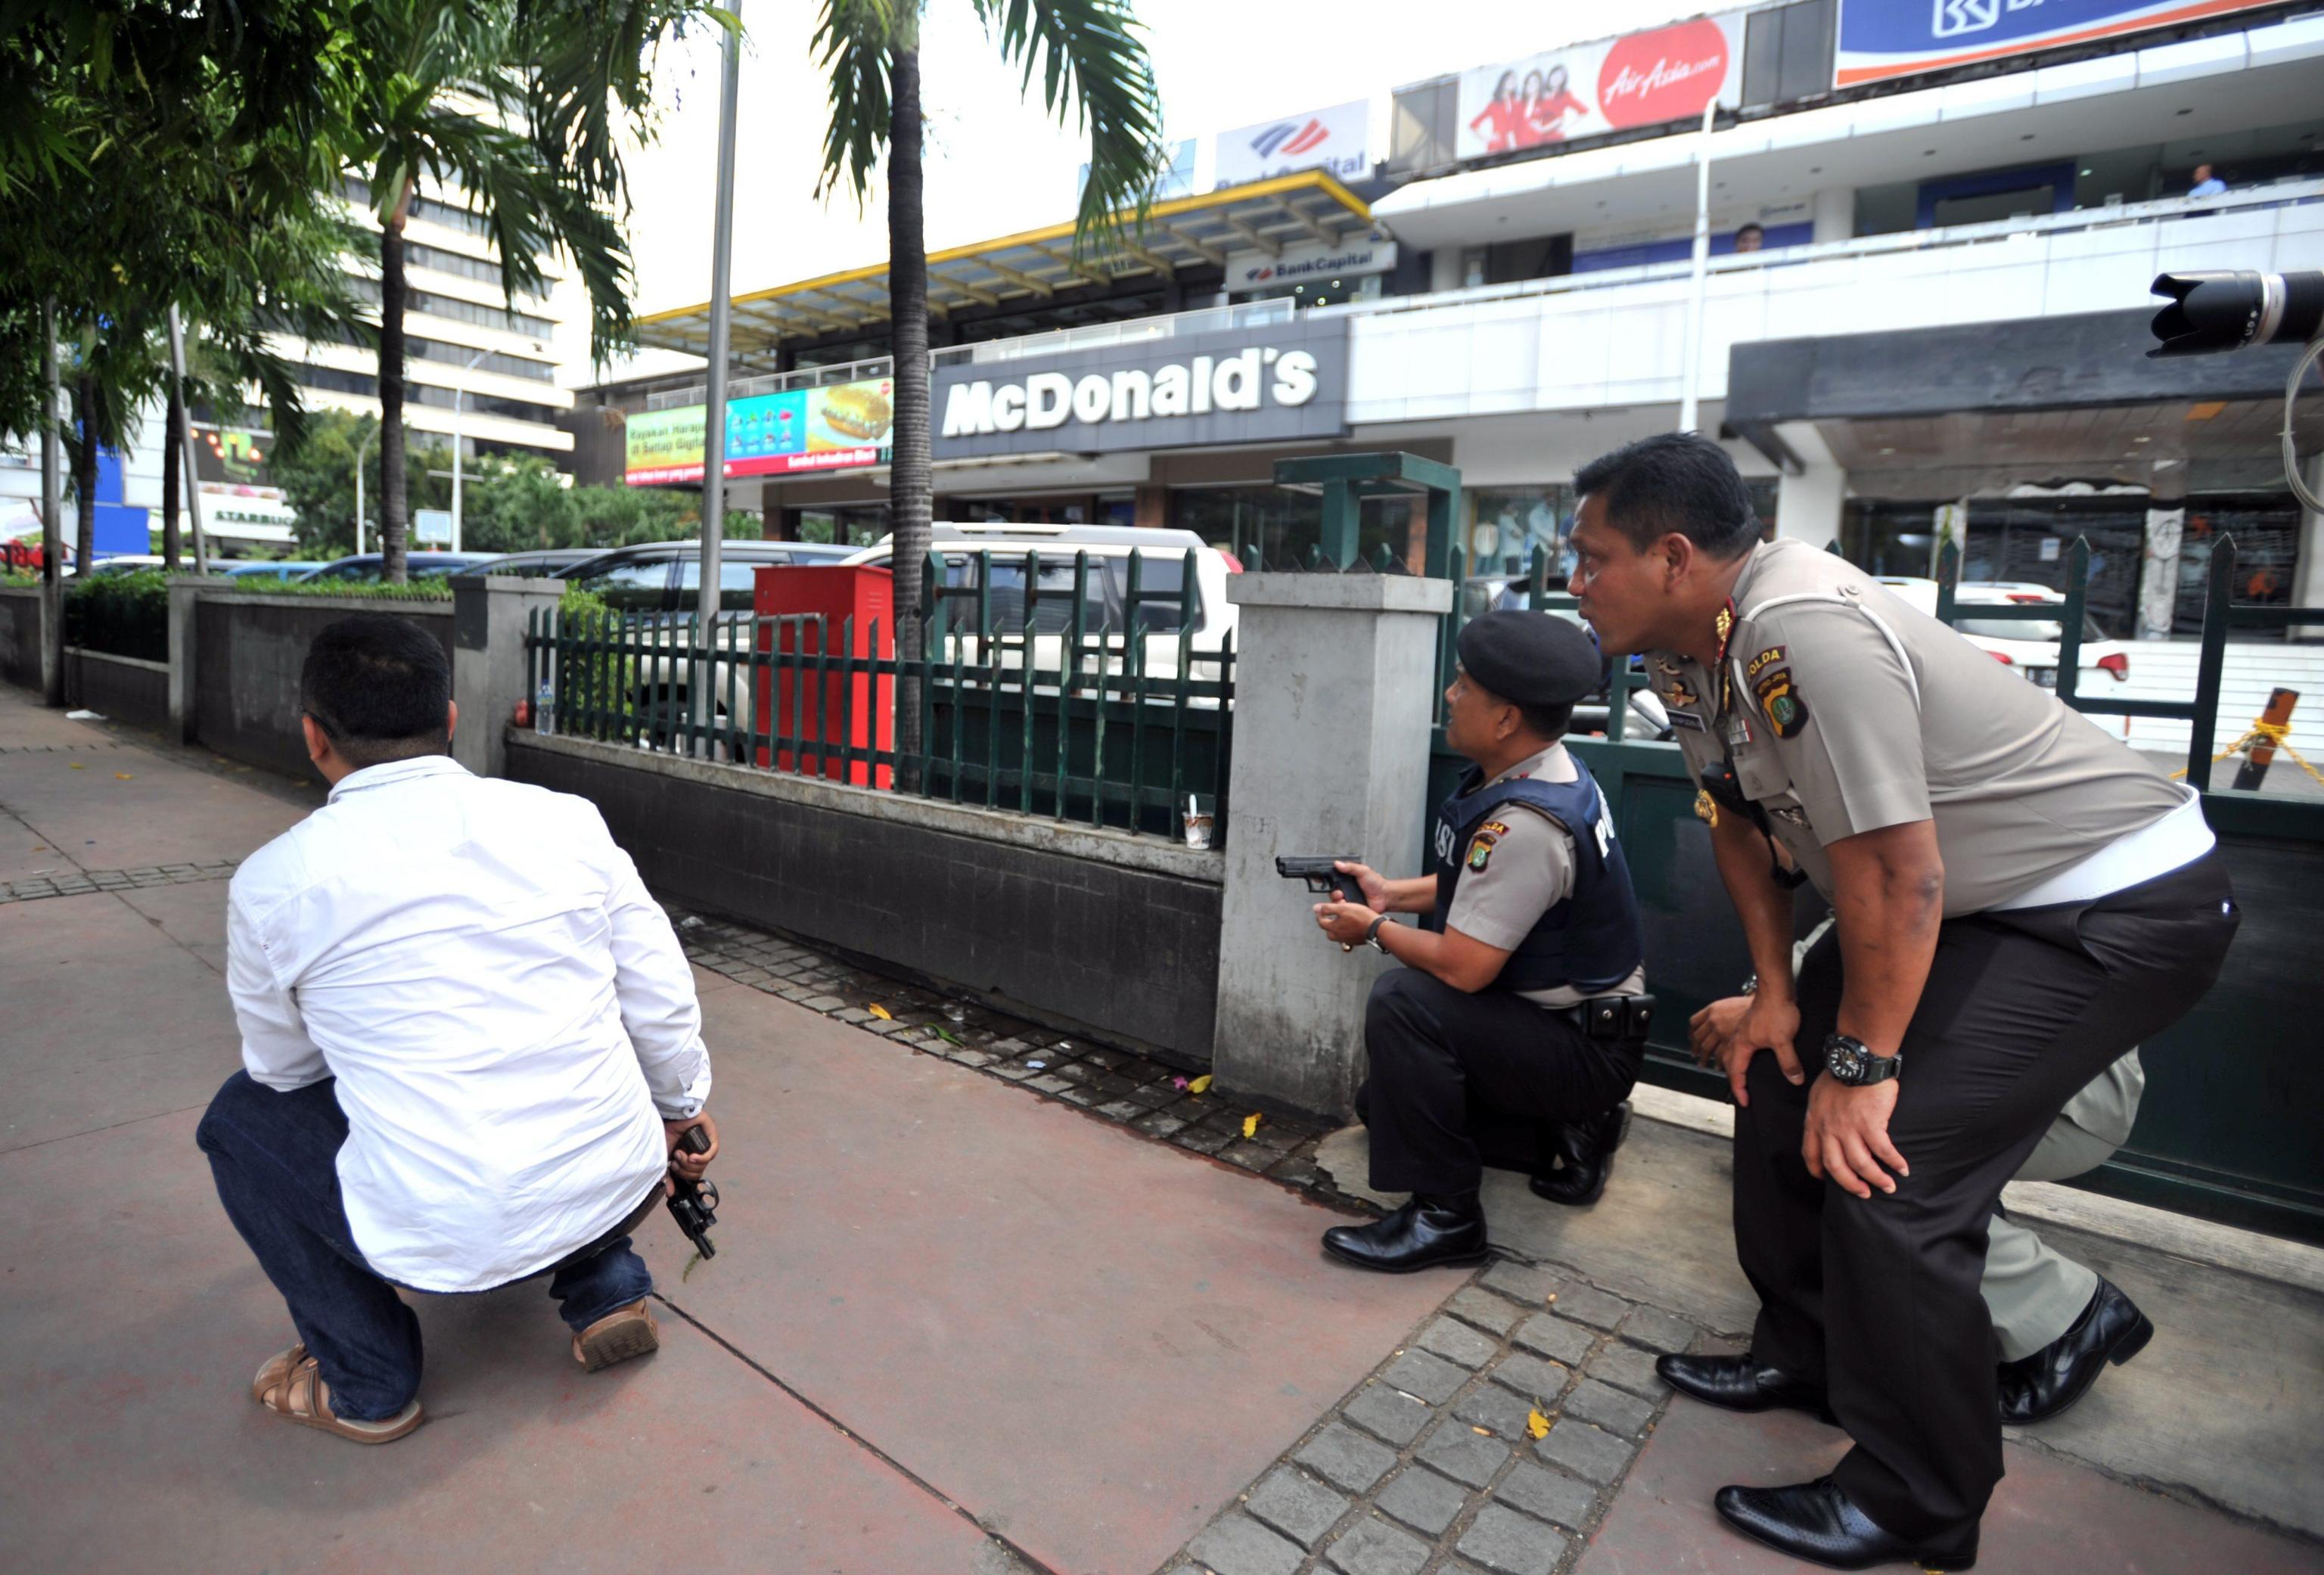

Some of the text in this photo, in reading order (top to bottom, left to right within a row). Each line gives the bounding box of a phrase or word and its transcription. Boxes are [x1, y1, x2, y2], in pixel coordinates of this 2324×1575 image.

[941, 346, 1318, 438] McDonald's
[672, 423, 705, 436] Harapa
[676, 436, 705, 452] Gigita
[216, 510, 293, 526] STARBUC
[1748, 649, 1781, 676] OLDA
